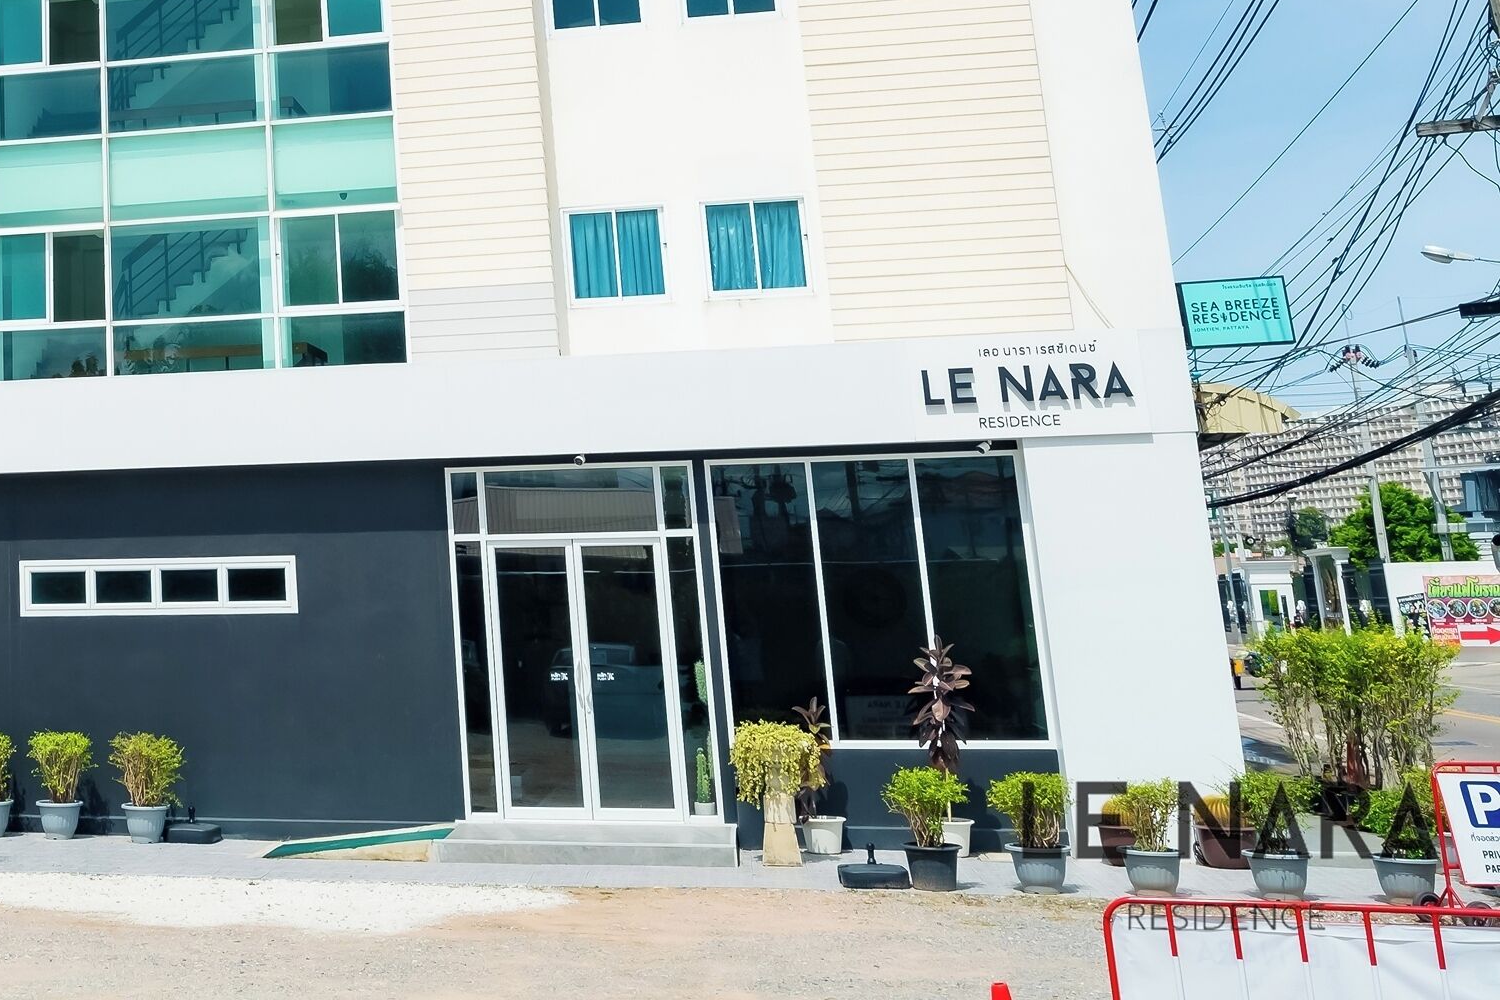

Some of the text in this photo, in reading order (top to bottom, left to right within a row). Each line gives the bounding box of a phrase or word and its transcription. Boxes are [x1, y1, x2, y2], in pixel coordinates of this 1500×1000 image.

[1191, 297, 1279, 313] SEA BREEZE
[978, 348, 999, 357] เลอ
[1003, 346, 1031, 356] นารา
[921, 361, 1133, 406] LE NARA
[979, 414, 1061, 429] RESIDENCE
[1467, 784, 1500, 825] P
